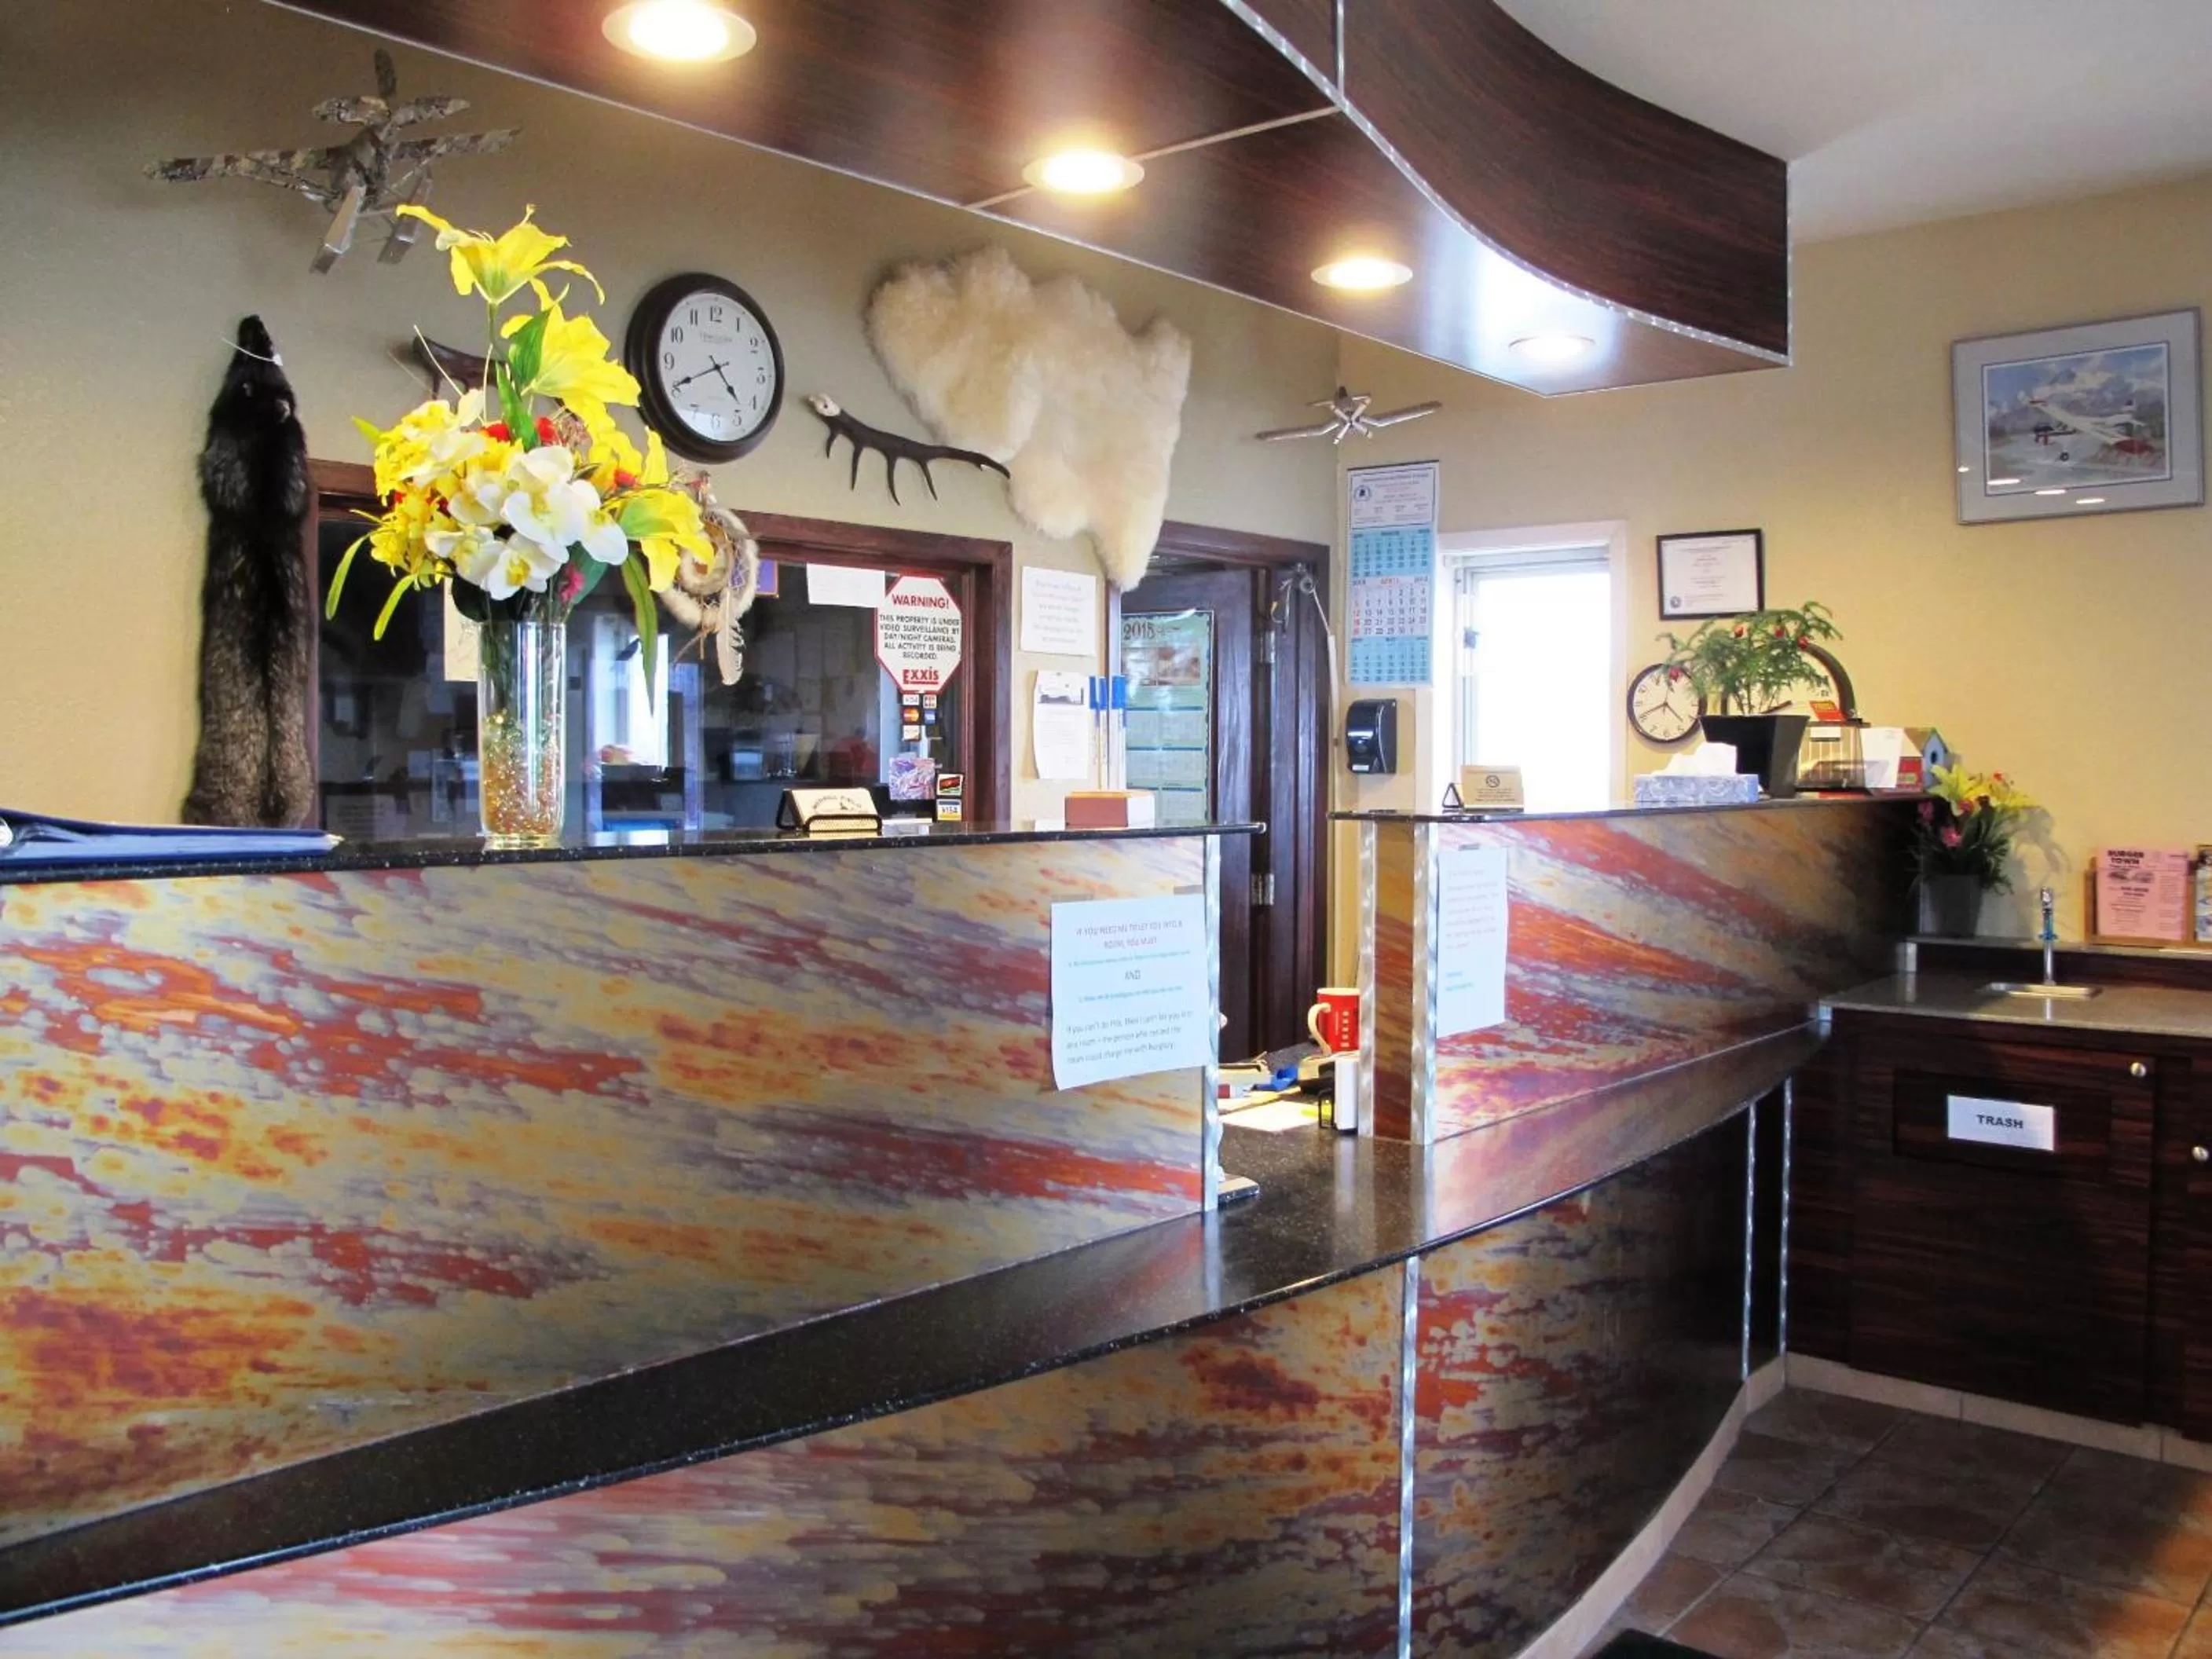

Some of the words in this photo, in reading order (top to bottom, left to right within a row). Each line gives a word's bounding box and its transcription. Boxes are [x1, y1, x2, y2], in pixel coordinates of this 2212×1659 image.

[690, 307, 698, 326] 11
[709, 306, 723, 324] 12
[671, 325, 683, 343] 10
[664, 352, 675, 370] 9
[892, 594, 949, 609] WARNING!
[896, 615, 928, 624] PROPERTY
[1976, 1114, 2023, 1129] TRASH
